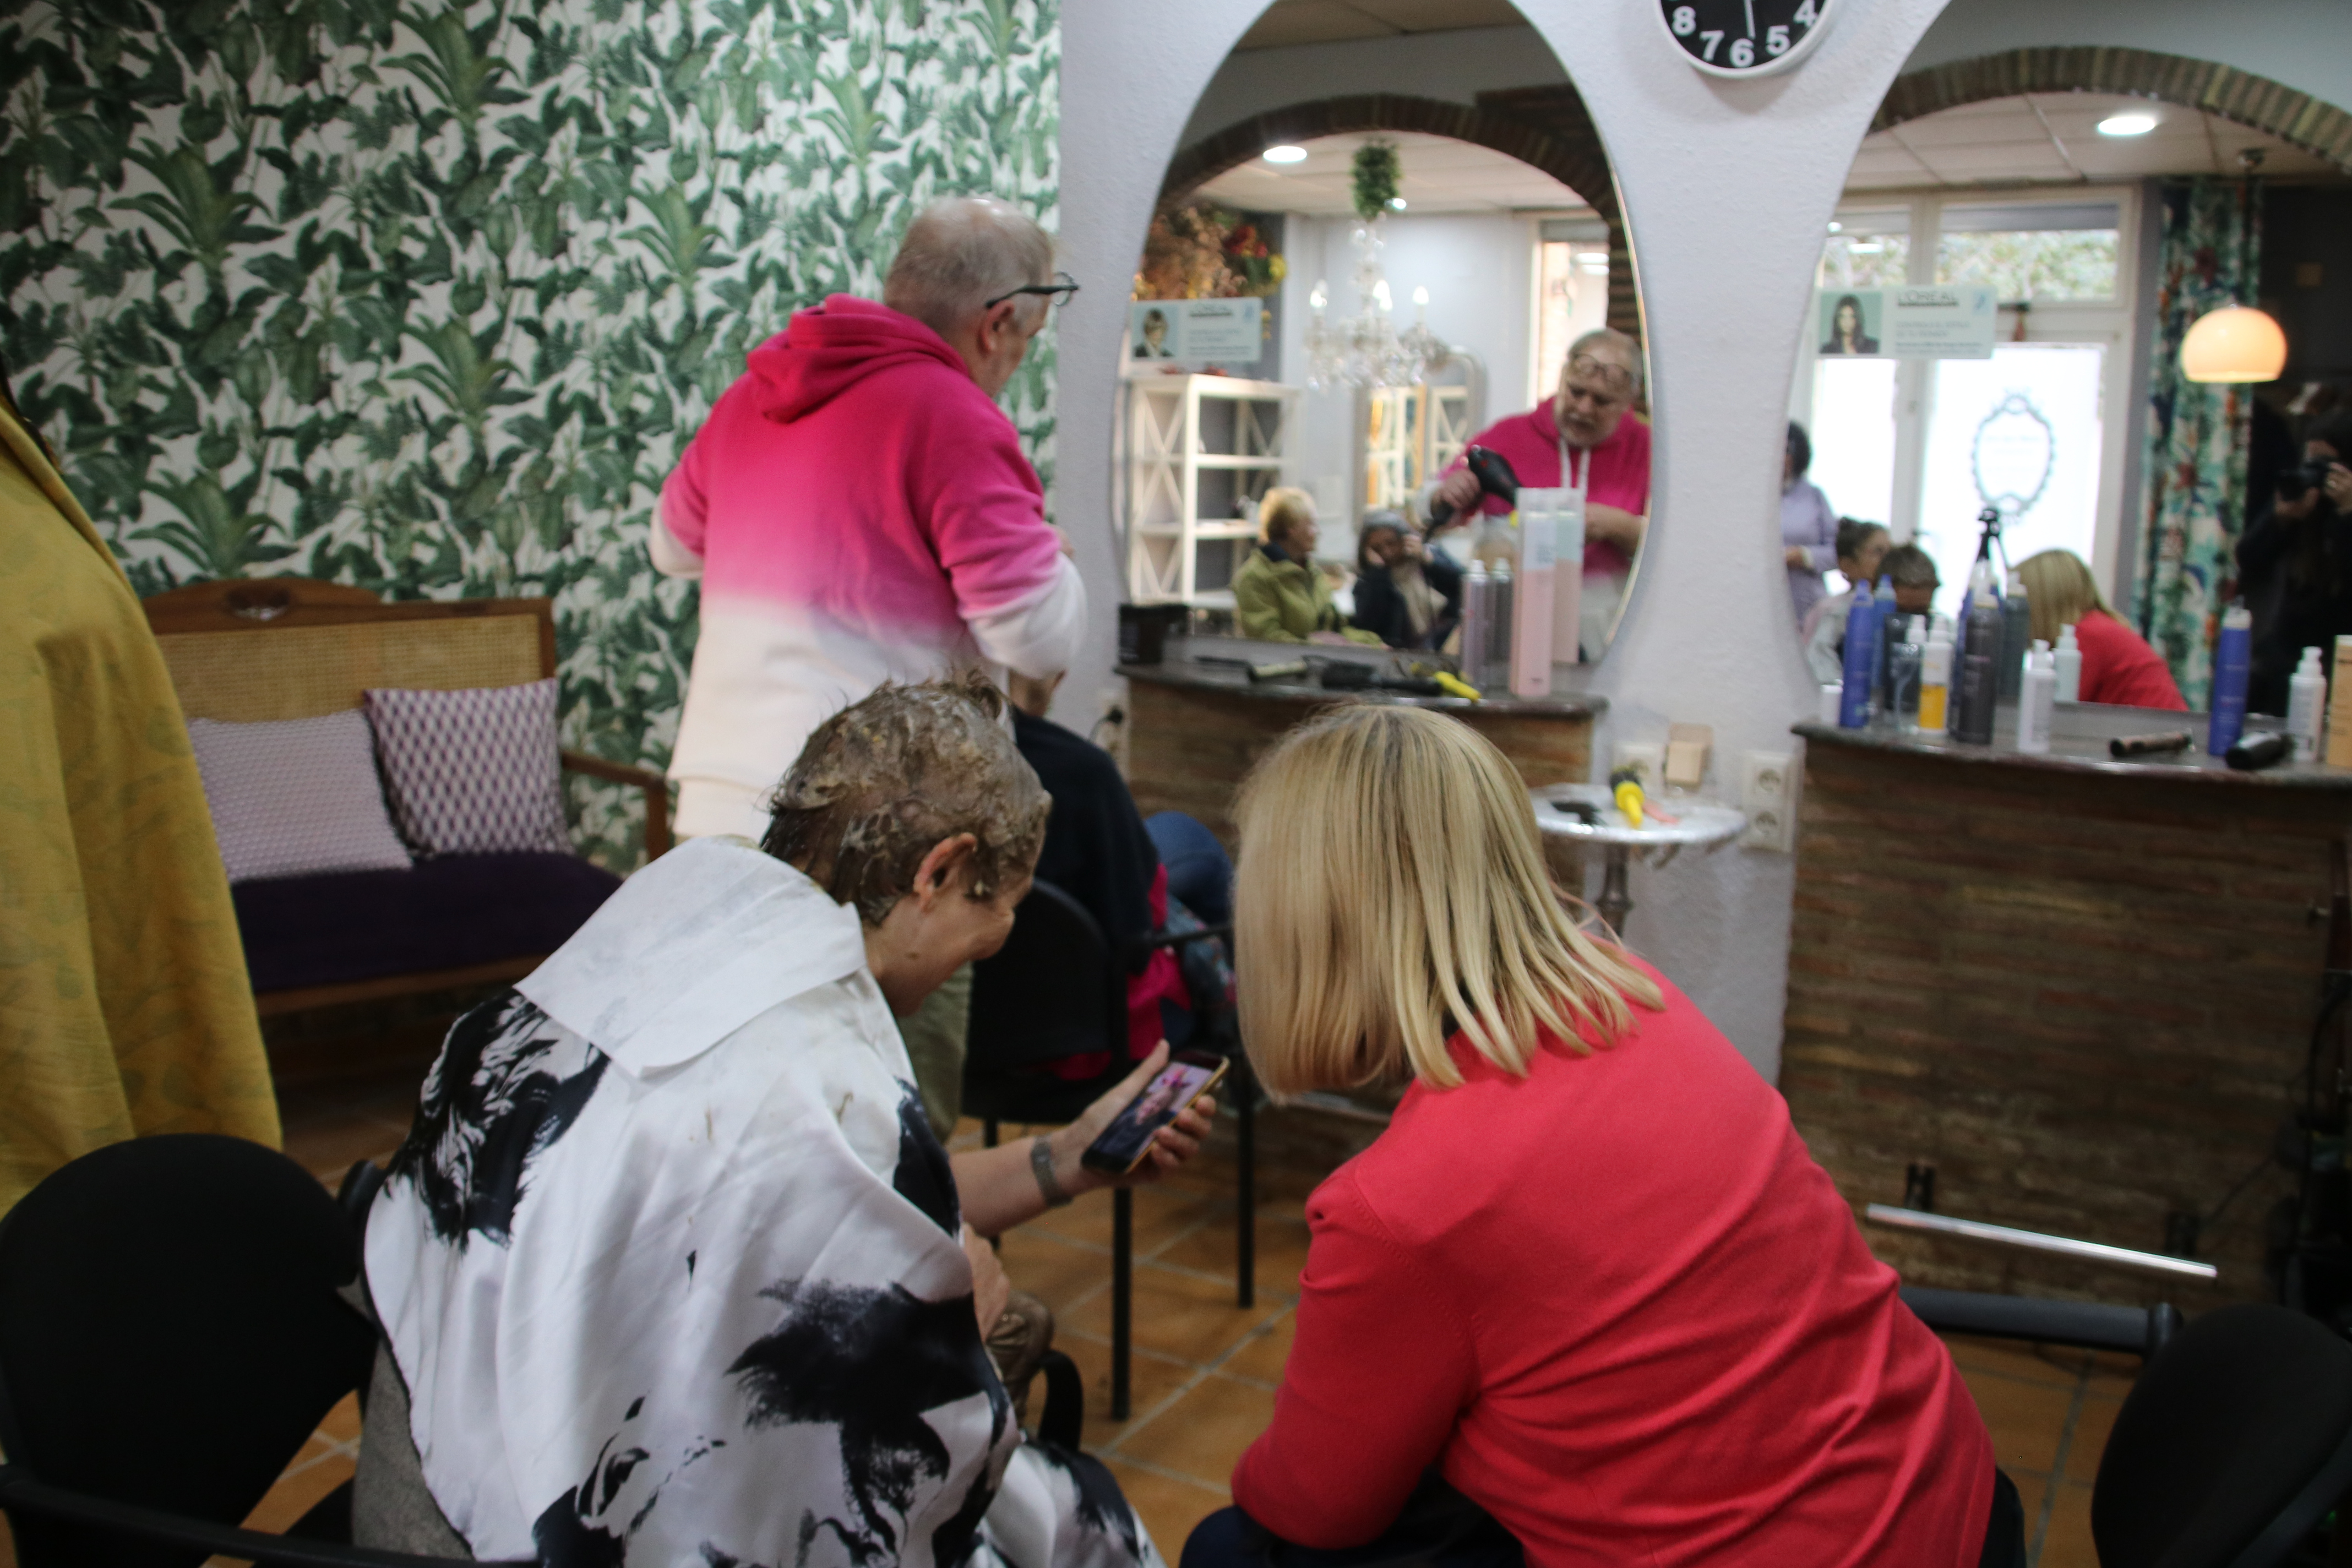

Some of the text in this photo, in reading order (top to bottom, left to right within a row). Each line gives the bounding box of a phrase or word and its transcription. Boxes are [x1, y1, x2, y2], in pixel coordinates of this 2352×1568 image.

[1672, 6, 1696, 36] 8
[1793, 0, 1819, 28] 4
[1699, 30, 1724, 62] 7
[1729, 37, 1755, 68] 6
[1765, 25, 1789, 55] 5
